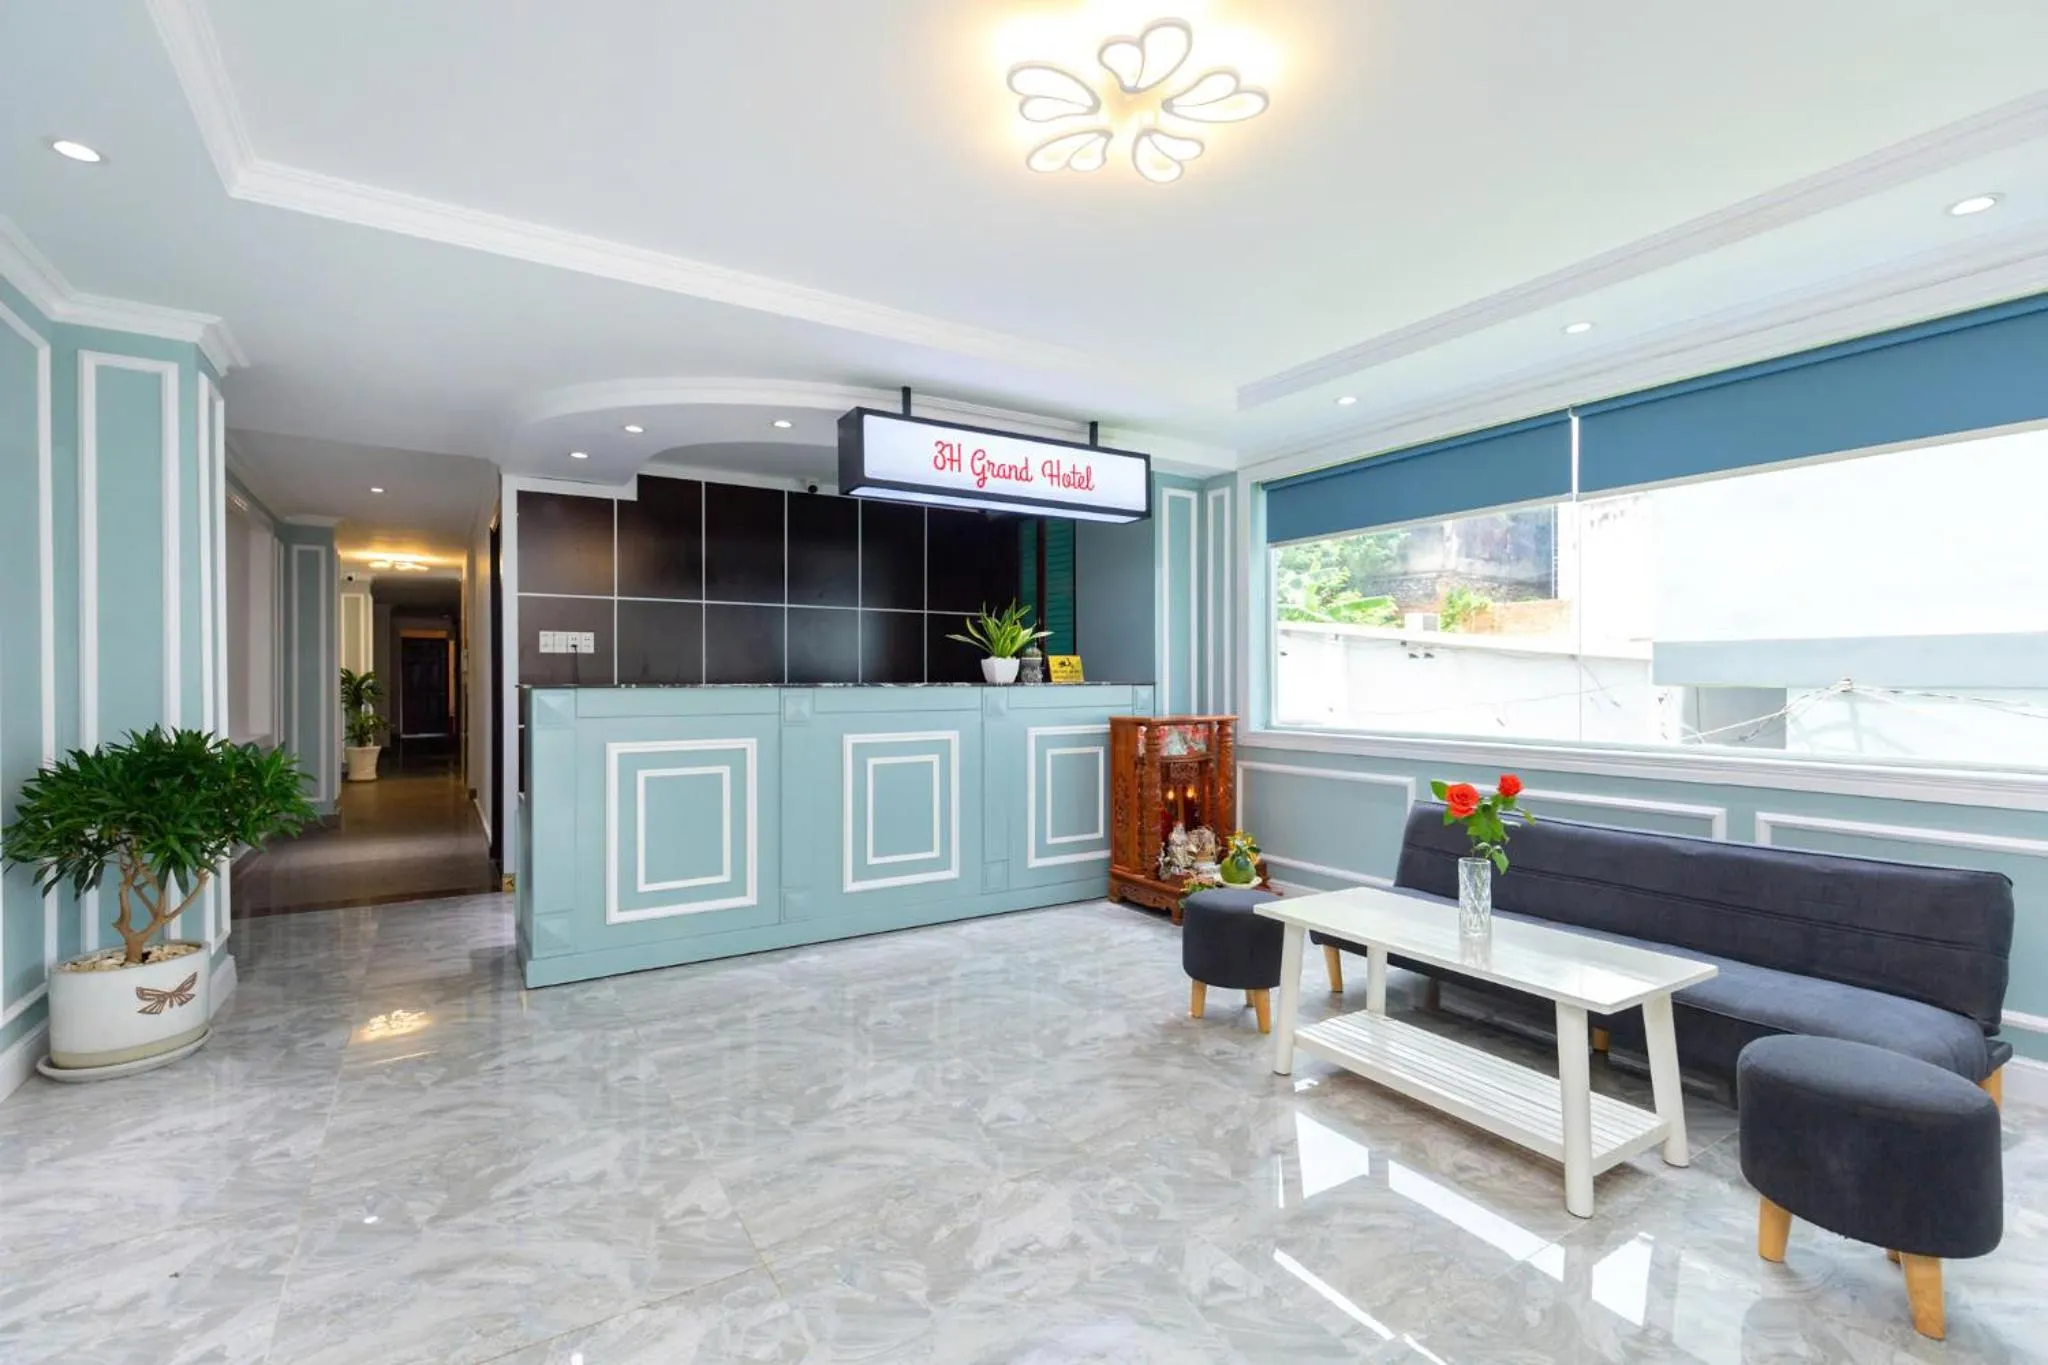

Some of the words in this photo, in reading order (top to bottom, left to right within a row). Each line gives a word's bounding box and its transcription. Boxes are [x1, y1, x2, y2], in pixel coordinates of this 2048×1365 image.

[932, 440, 962, 472] 3H
[970, 448, 1033, 488] Grand
[1041, 459, 1095, 491] Hotel
